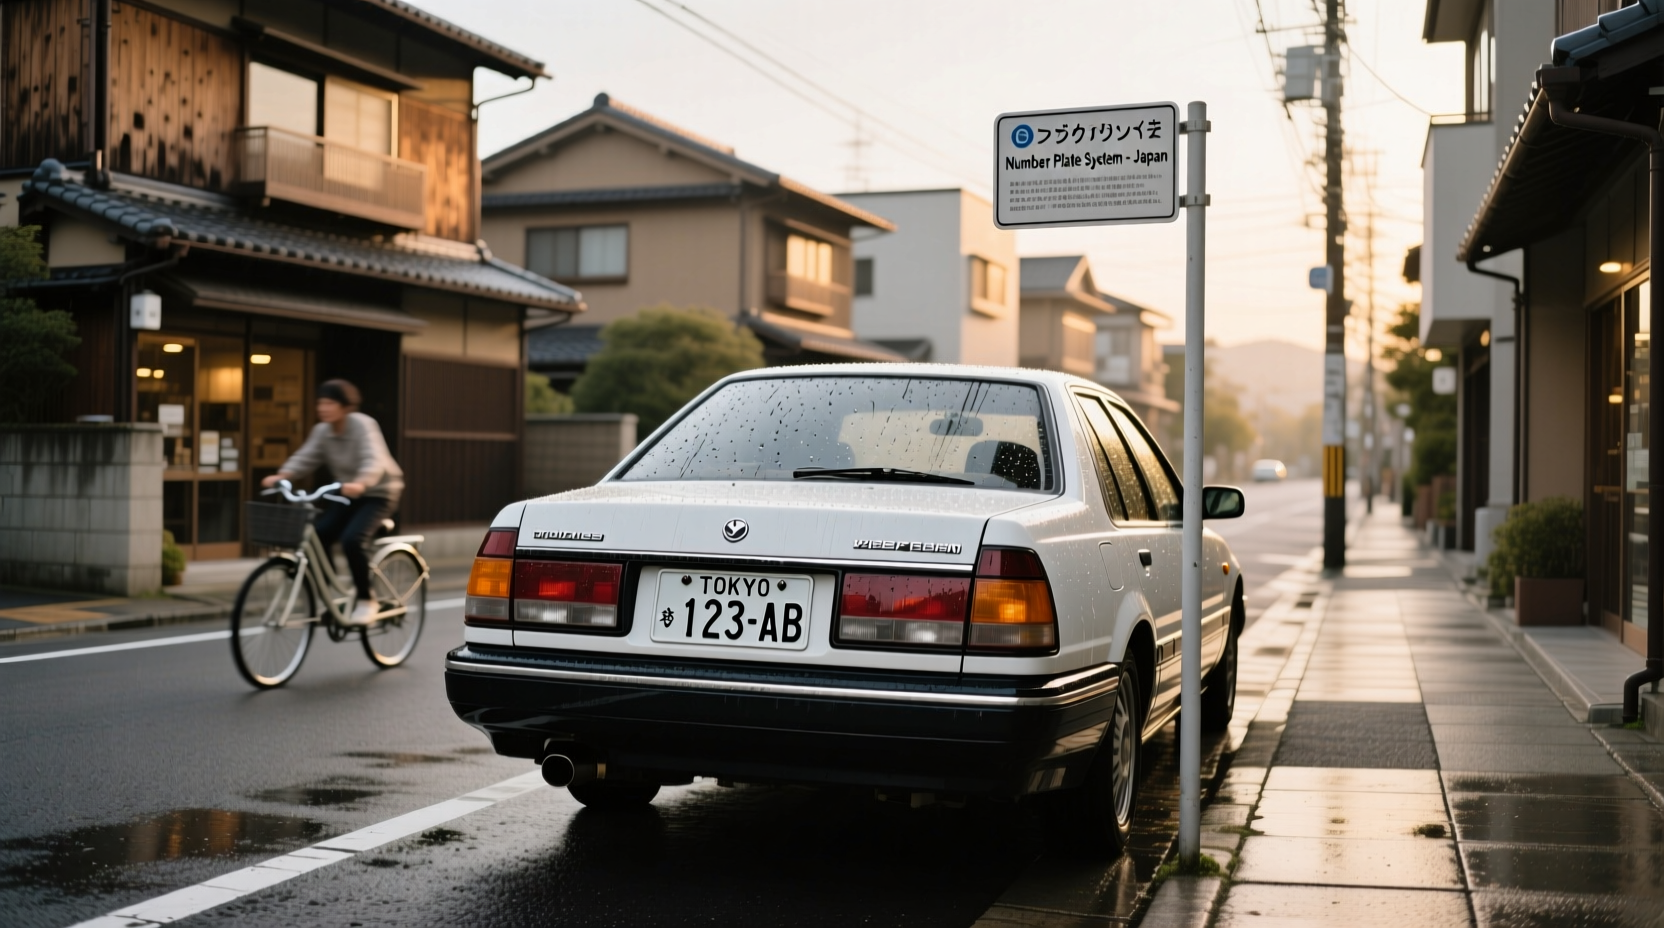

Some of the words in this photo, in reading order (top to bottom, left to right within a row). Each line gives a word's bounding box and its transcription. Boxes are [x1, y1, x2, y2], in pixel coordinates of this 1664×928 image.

[1005, 154, 1051, 171] Number
[1053, 151, 1082, 169] Plate
[1133, 149, 1168, 167] Japan
[700, 575, 770, 597] TOKYO
[685, 597, 803, 643] 123-AB
